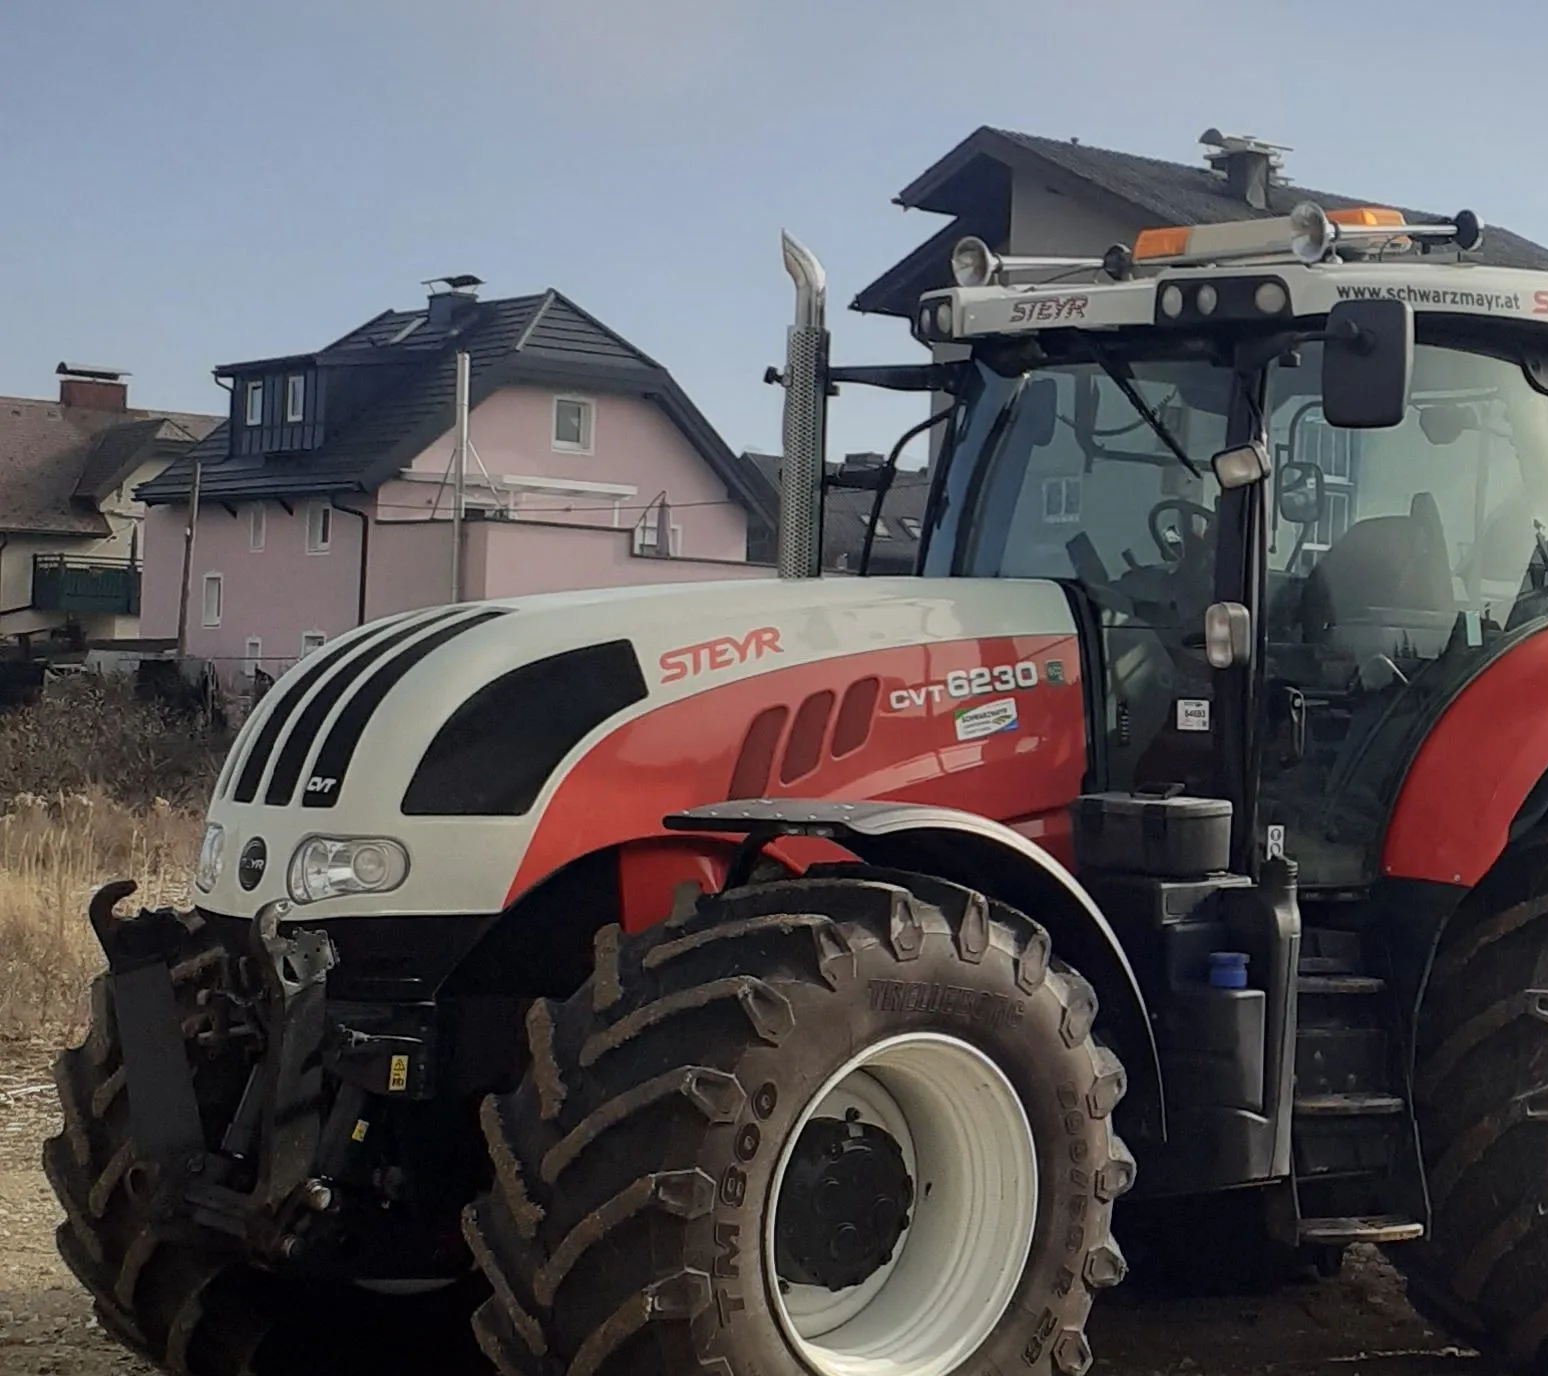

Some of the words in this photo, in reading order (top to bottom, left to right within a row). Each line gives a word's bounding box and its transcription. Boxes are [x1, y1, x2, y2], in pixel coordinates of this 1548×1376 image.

[1010, 294, 1089, 322] STEYR
[1336, 285, 1520, 311] www.schwarzmayr.at
[659, 626, 785, 684] STEYR
[889, 684, 945, 710] CVT
[947, 660, 1038, 698] 6230
[306, 776, 337, 793] CVT
[714, 1080, 779, 1329] TM800
